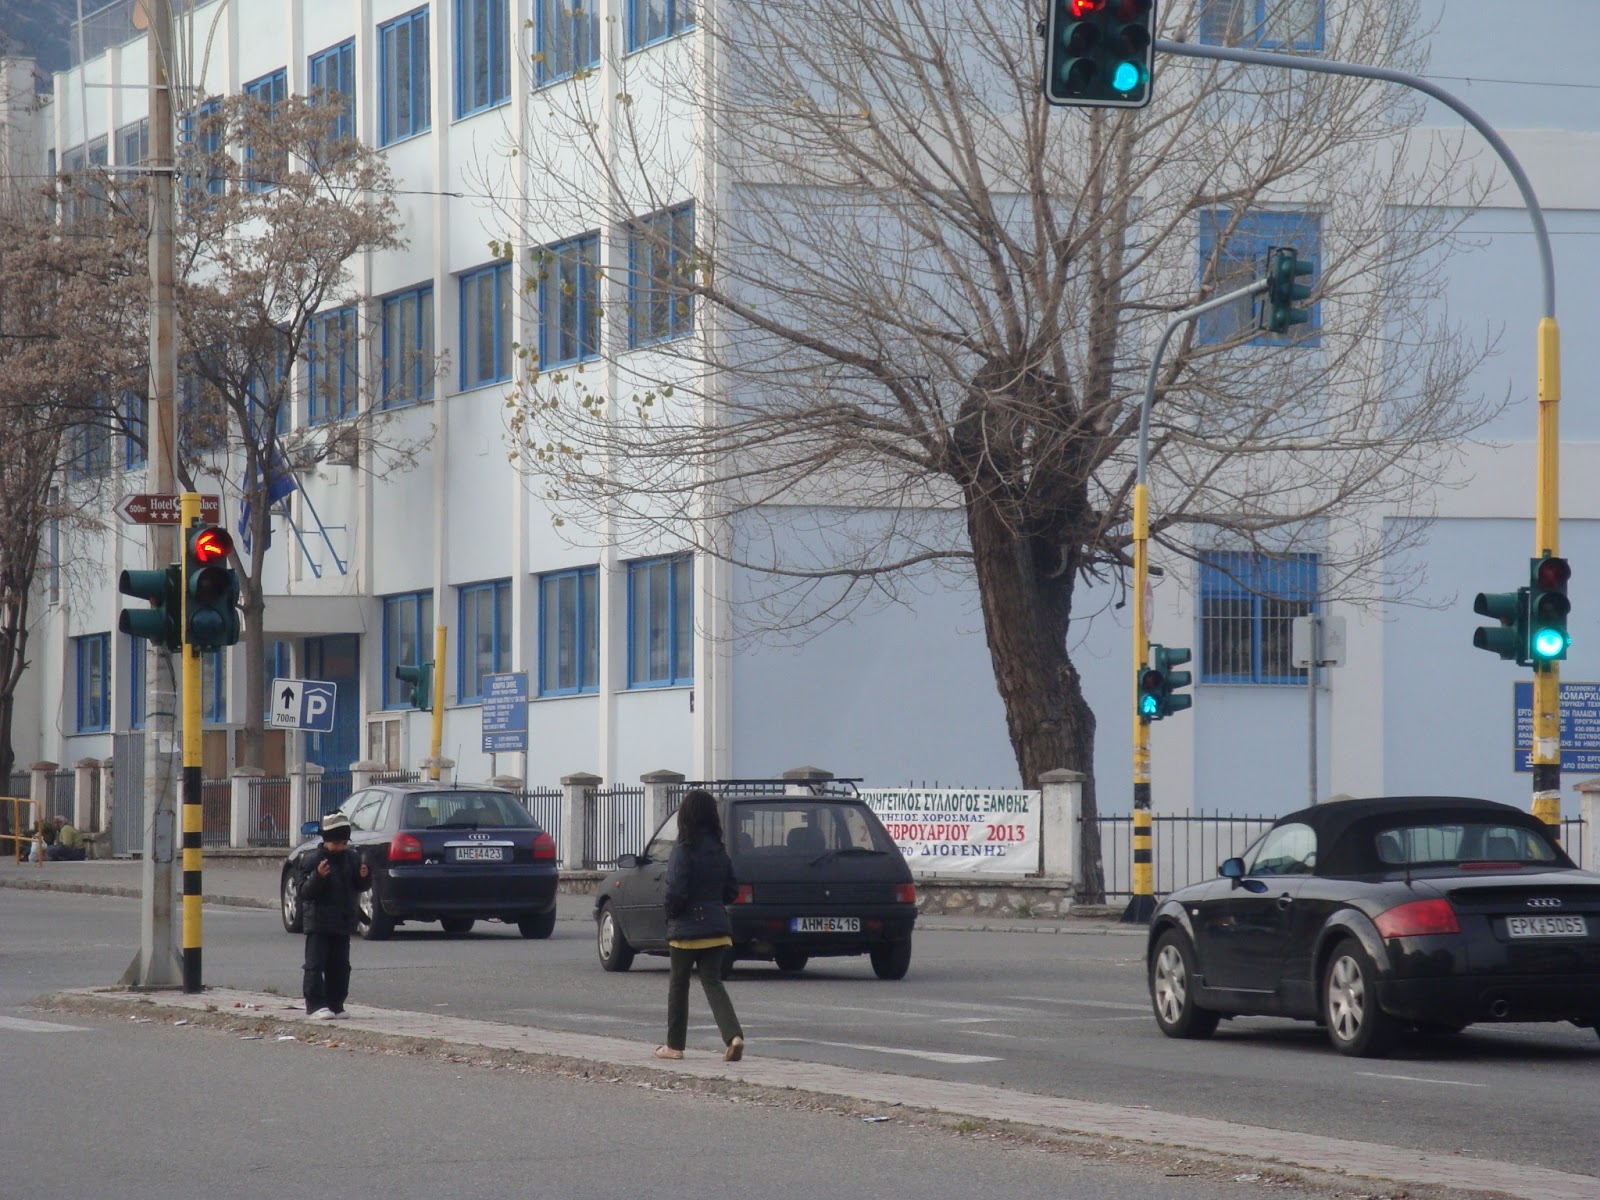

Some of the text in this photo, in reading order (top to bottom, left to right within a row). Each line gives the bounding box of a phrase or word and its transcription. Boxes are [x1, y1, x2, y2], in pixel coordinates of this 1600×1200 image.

[129, 504, 147, 513] 500m
[150, 498, 173, 510] Hotel
[306, 695, 327, 724] P
[276, 713, 296, 723] 700m
[924, 793, 980, 812] ΣΥΛΛΟΓΟΣ
[983, 794, 1029, 813] ΞΑΝΘΗΣ
[986, 825, 1025, 842] 2013
